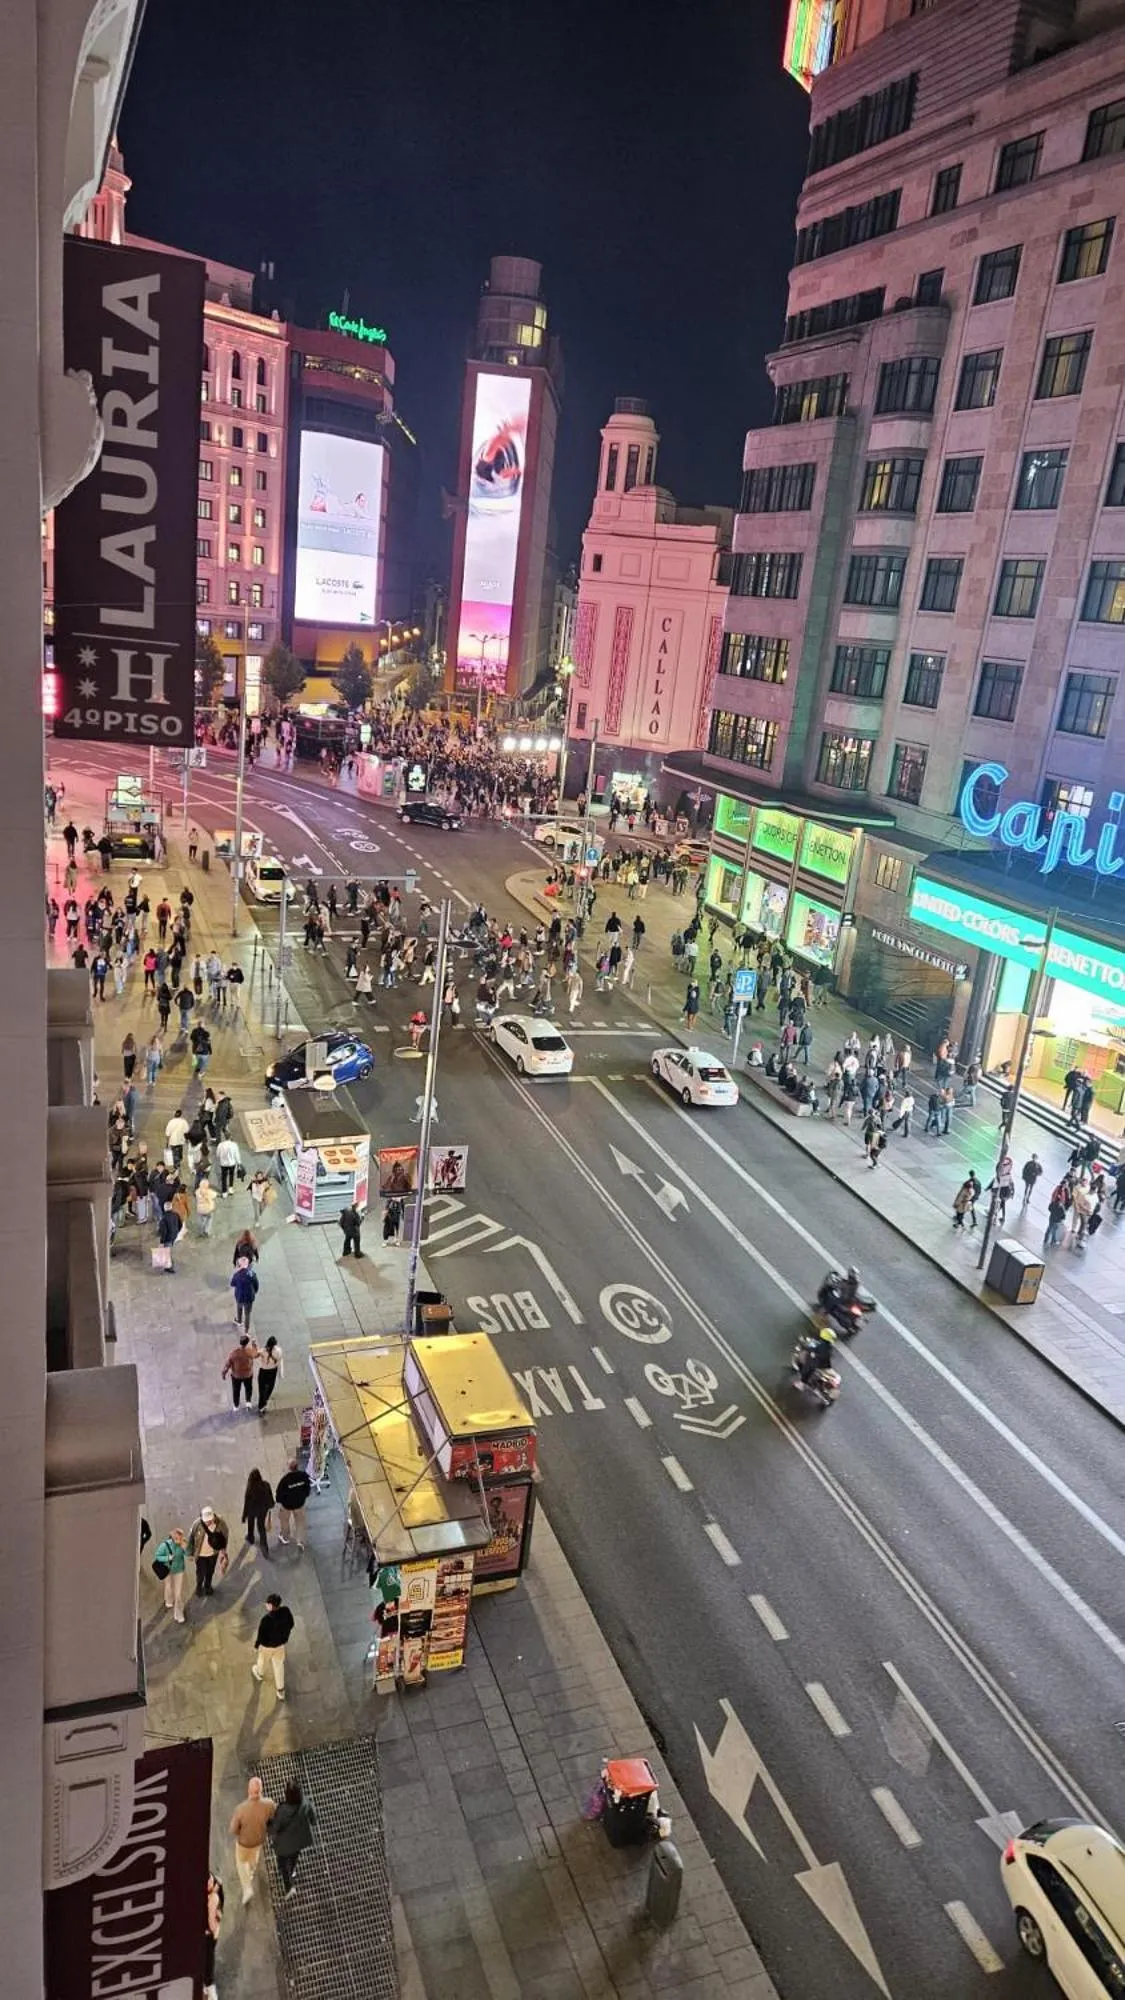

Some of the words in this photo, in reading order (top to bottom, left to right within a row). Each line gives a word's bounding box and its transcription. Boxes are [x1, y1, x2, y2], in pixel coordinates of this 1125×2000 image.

[100, 273, 161, 630] LAURIA
[110, 648, 173, 705] H
[648, 617, 673, 735] CALLAO
[1047, 943, 1125, 991] BENETTO
[466, 1290, 551, 1334] BUS
[615, 1298, 660, 1329] 30
[511, 1365, 607, 1418] TAX
[491, 1438, 528, 1450] MADRID
